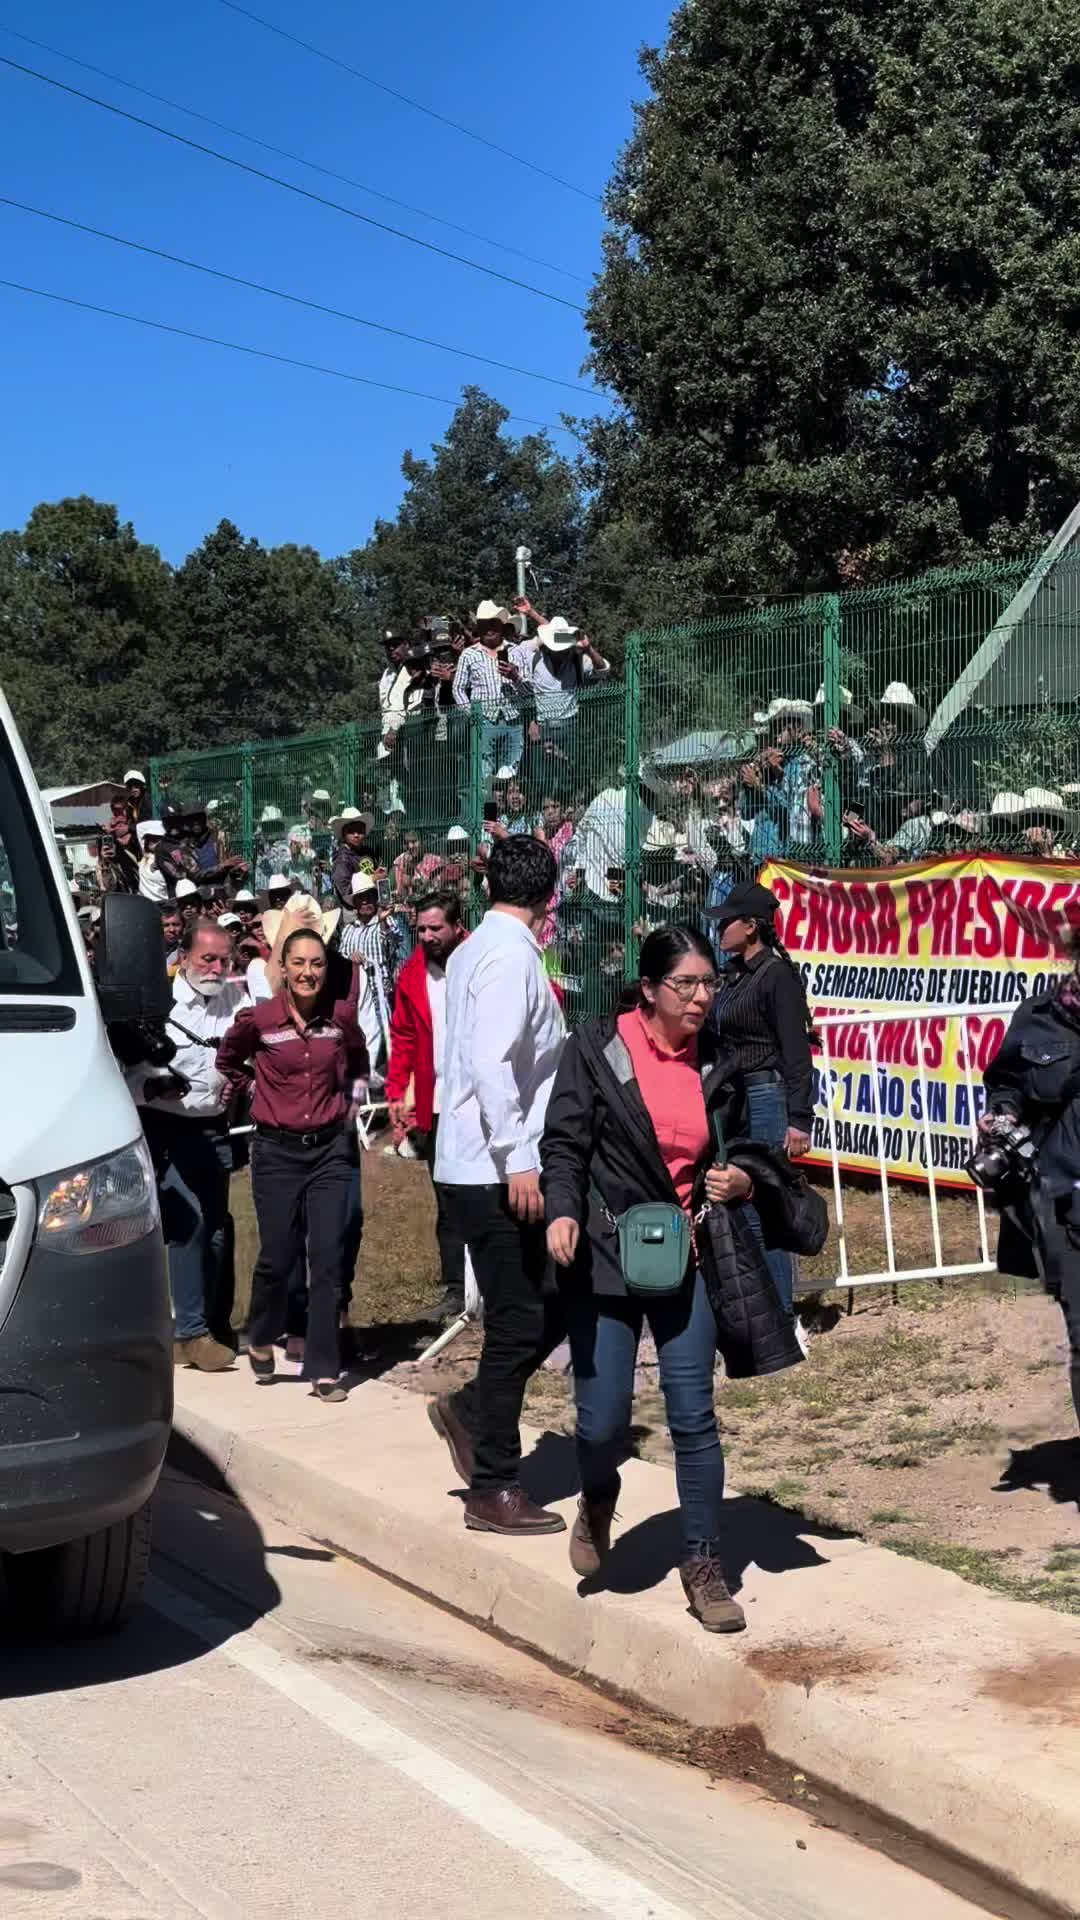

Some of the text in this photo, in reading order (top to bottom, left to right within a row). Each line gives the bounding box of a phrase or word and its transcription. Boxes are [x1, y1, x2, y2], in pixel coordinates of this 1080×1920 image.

[812, 963, 925, 1002] SEMBRADORES
[927, 968, 947, 1003] DE
[957, 1014, 1005, 1072] SO
[842, 1071, 853, 1110] 1
[855, 1067, 905, 1118] AÑO
[910, 1078, 947, 1124] SIN
[954, 1084, 985, 1125] RE
[811, 1116, 974, 1170] RABAJANDO Y QUERE
